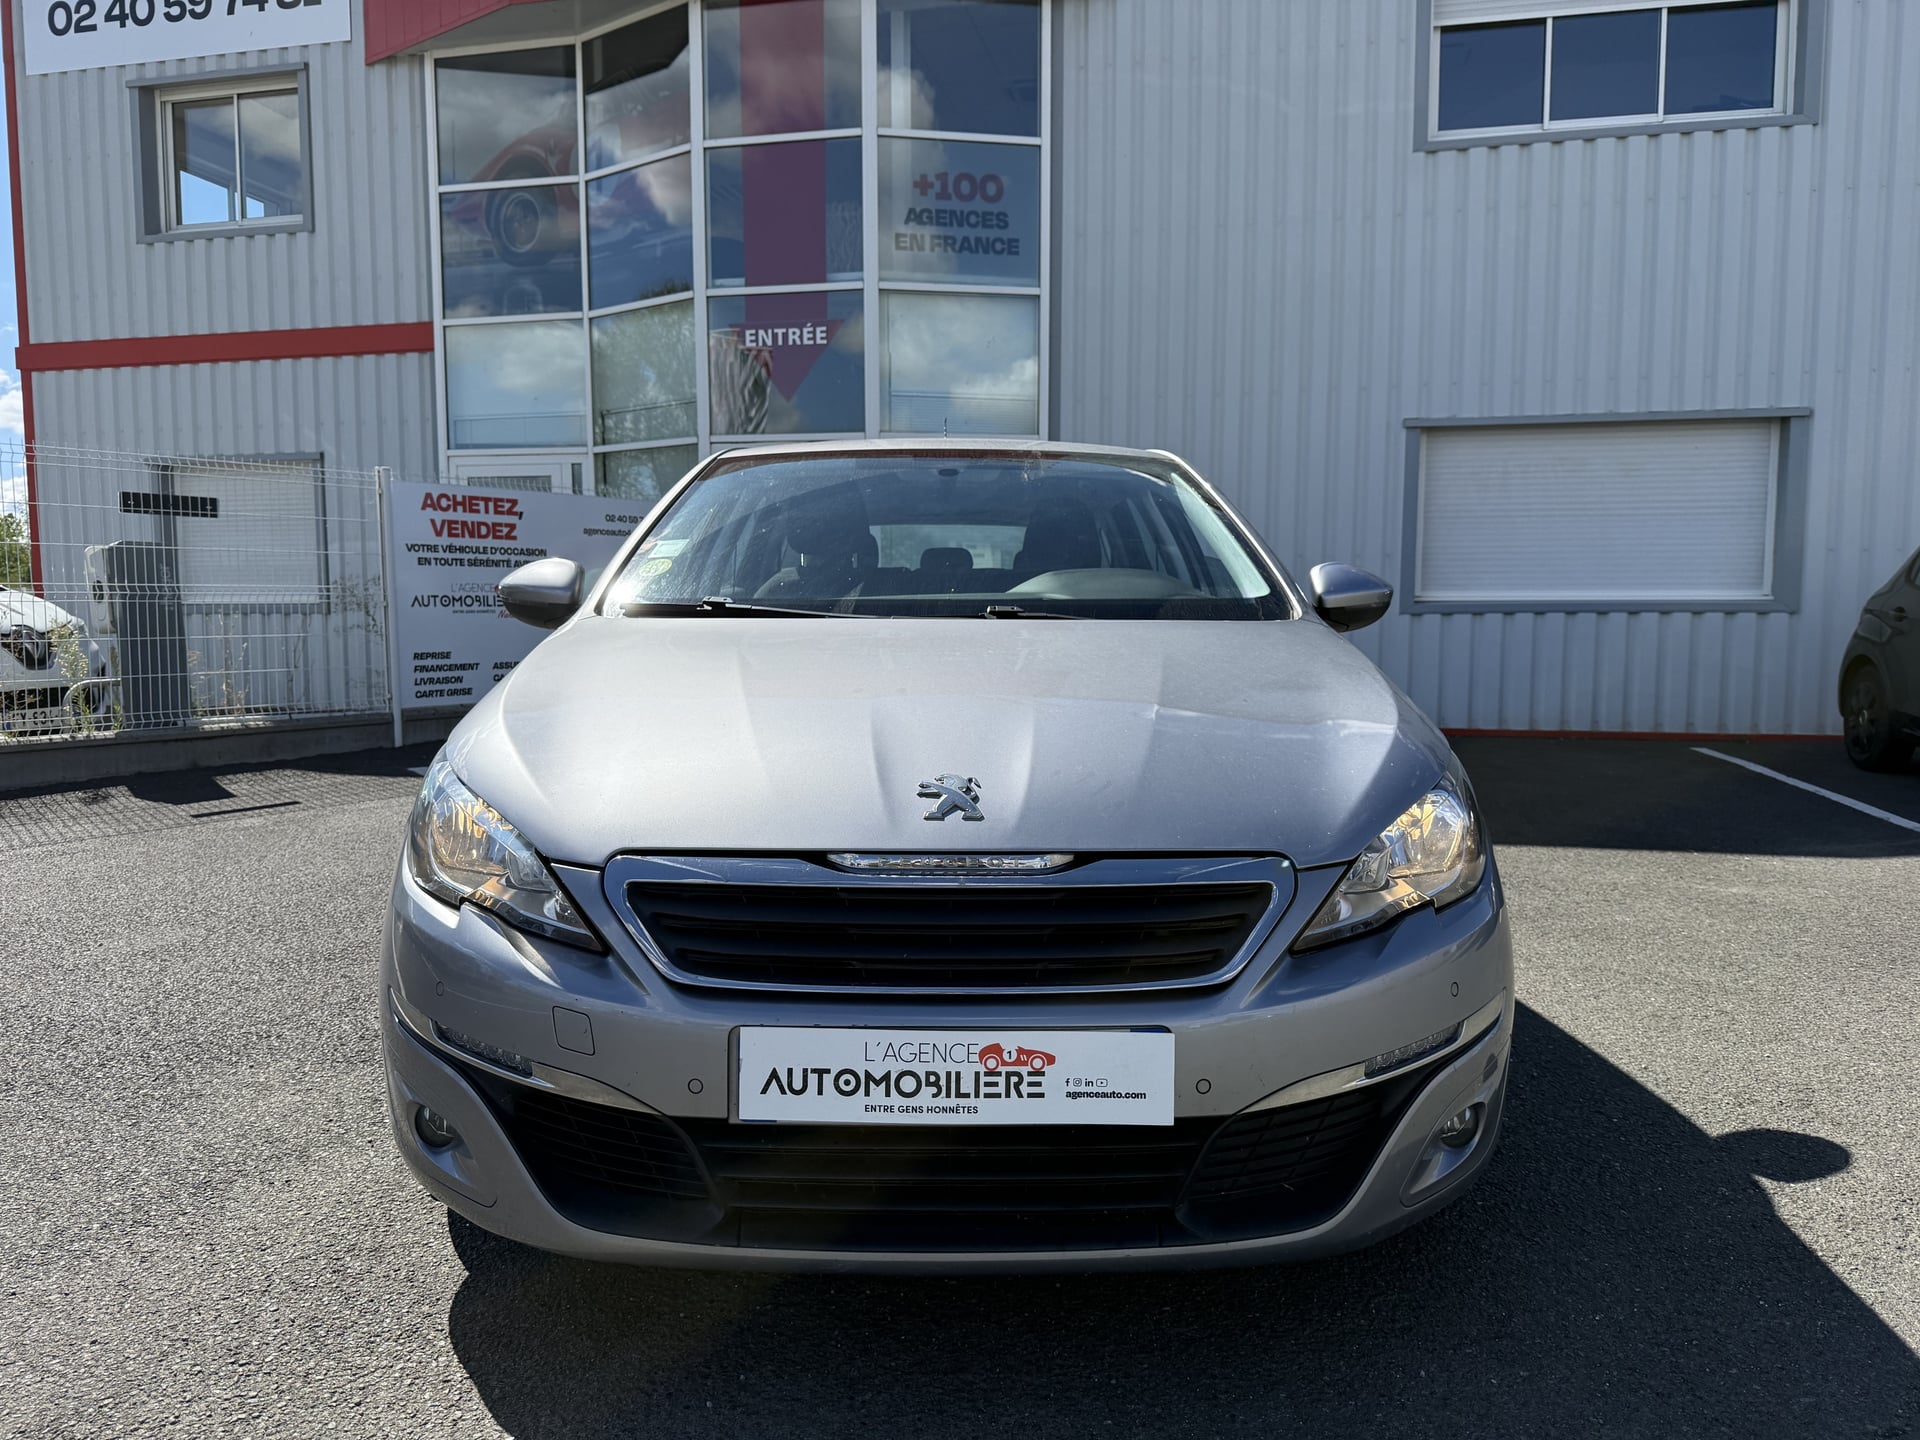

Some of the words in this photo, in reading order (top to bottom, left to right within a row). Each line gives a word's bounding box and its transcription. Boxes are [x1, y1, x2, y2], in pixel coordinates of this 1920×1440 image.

[48, 0, 97, 36] 02
[104, 0, 154, 28] 40
[913, 172, 1004, 204] +100
[904, 207, 1009, 229] AGENCES
[895, 233, 925, 252] EN
[929, 235, 1020, 256] FRANCE
[745, 323, 828, 346] ENTRÉE
[421, 492, 523, 520] ACHETEZ,
[605, 514, 616, 522] 02
[430, 518, 517, 541] VENDEZ
[406, 543, 440, 553] VOTRE
[441, 543, 488, 555] VÉHICULE
[490, 546, 547, 557] D'OCCASION
[417, 557, 431, 566] EN
[433, 557, 466, 567] TOUTE
[467, 557, 512, 569] SÉRÉNITÉ
[451, 583, 495, 593] L'AGENCE
[413, 652, 452, 661] REPRISE
[414, 663, 480, 673] FINANCEMENT
[414, 676, 463, 686] LIVRAISON
[415, 689, 445, 699] CARTE
[446, 688, 473, 697] GRISE
[864, 1041, 980, 1063] L'AGENCE
[1065, 1091, 1147, 1100] agenceauto.com
[864, 1104, 895, 1113] ENTRE
[897, 1105, 924, 1114] GENS
[926, 1103, 979, 1114] HONNÊTES
